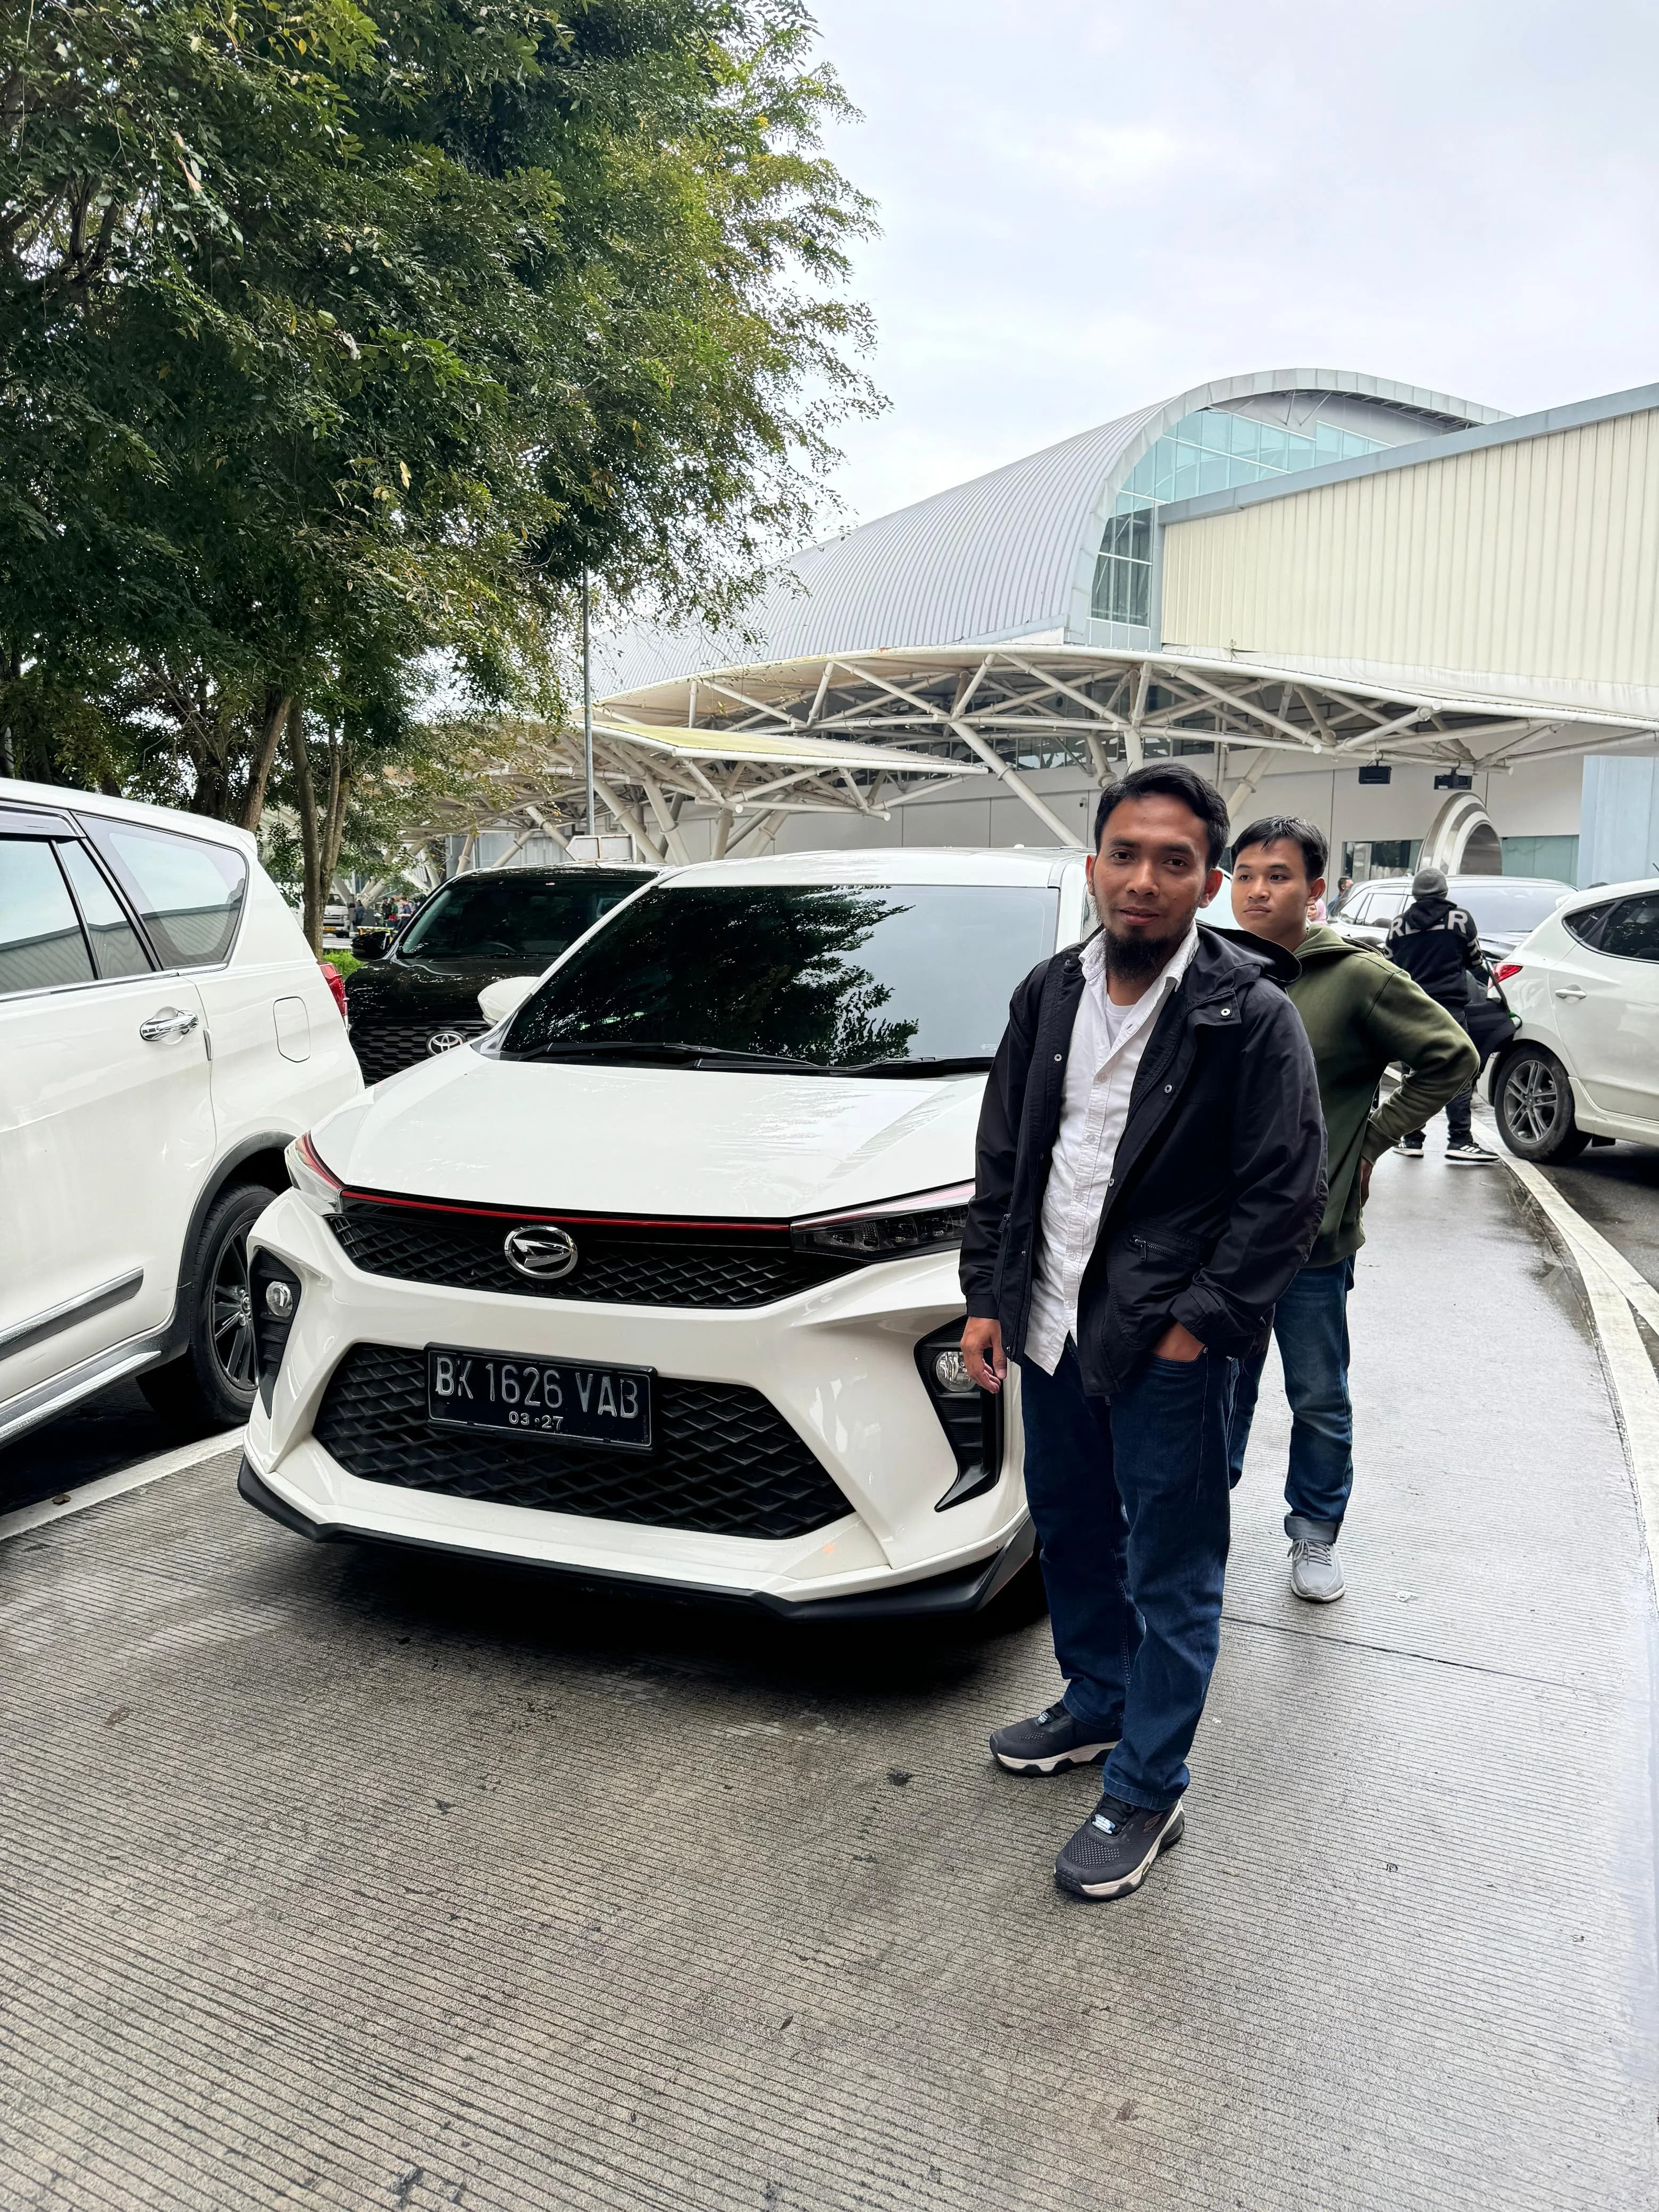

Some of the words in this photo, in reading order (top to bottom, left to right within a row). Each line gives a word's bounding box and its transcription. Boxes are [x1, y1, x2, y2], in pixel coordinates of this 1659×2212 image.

[436, 1356, 474, 1400] BK
[485, 1363, 563, 1409] 1626
[575, 1372, 639, 1419] VAB
